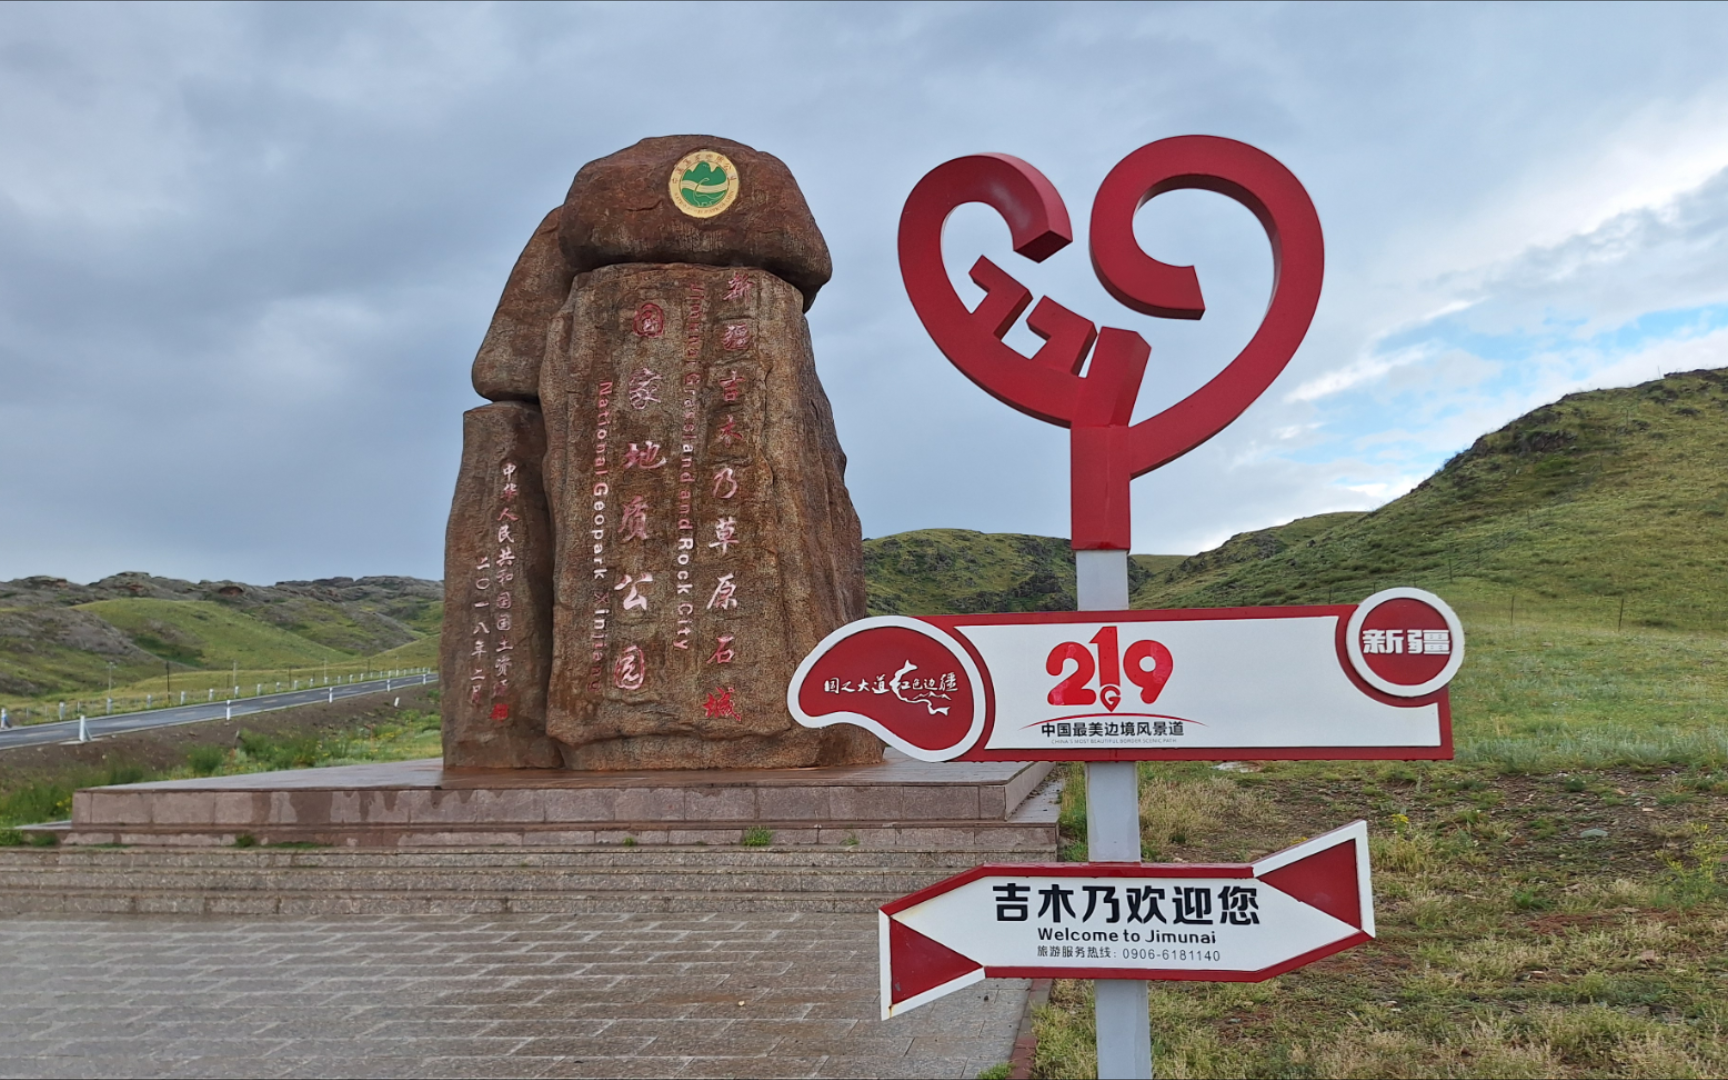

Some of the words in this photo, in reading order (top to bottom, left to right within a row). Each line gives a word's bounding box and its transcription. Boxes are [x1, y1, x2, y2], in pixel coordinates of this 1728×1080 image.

[594, 381, 613, 475] National
[679, 373, 700, 483] Grassland
[591, 482, 609, 579] Geopark
[678, 490, 693, 530] and
[490, 463, 518, 720] 中华人民共和国国土资
[676, 537, 694, 594] Rock
[589, 592, 609, 692] Xinjiang
[673, 603, 693, 649] City
[1363, 629, 1450, 654] 新疆
[1046, 626, 1174, 706] 219
[1041, 721, 1185, 738] 中国最美边境风景道
[993, 882, 1260, 925] 吉木乃欢迎您
[1037, 928, 1119, 942] Welcome
[1123, 929, 1140, 942] to
[1145, 930, 1217, 944] Jimunai
